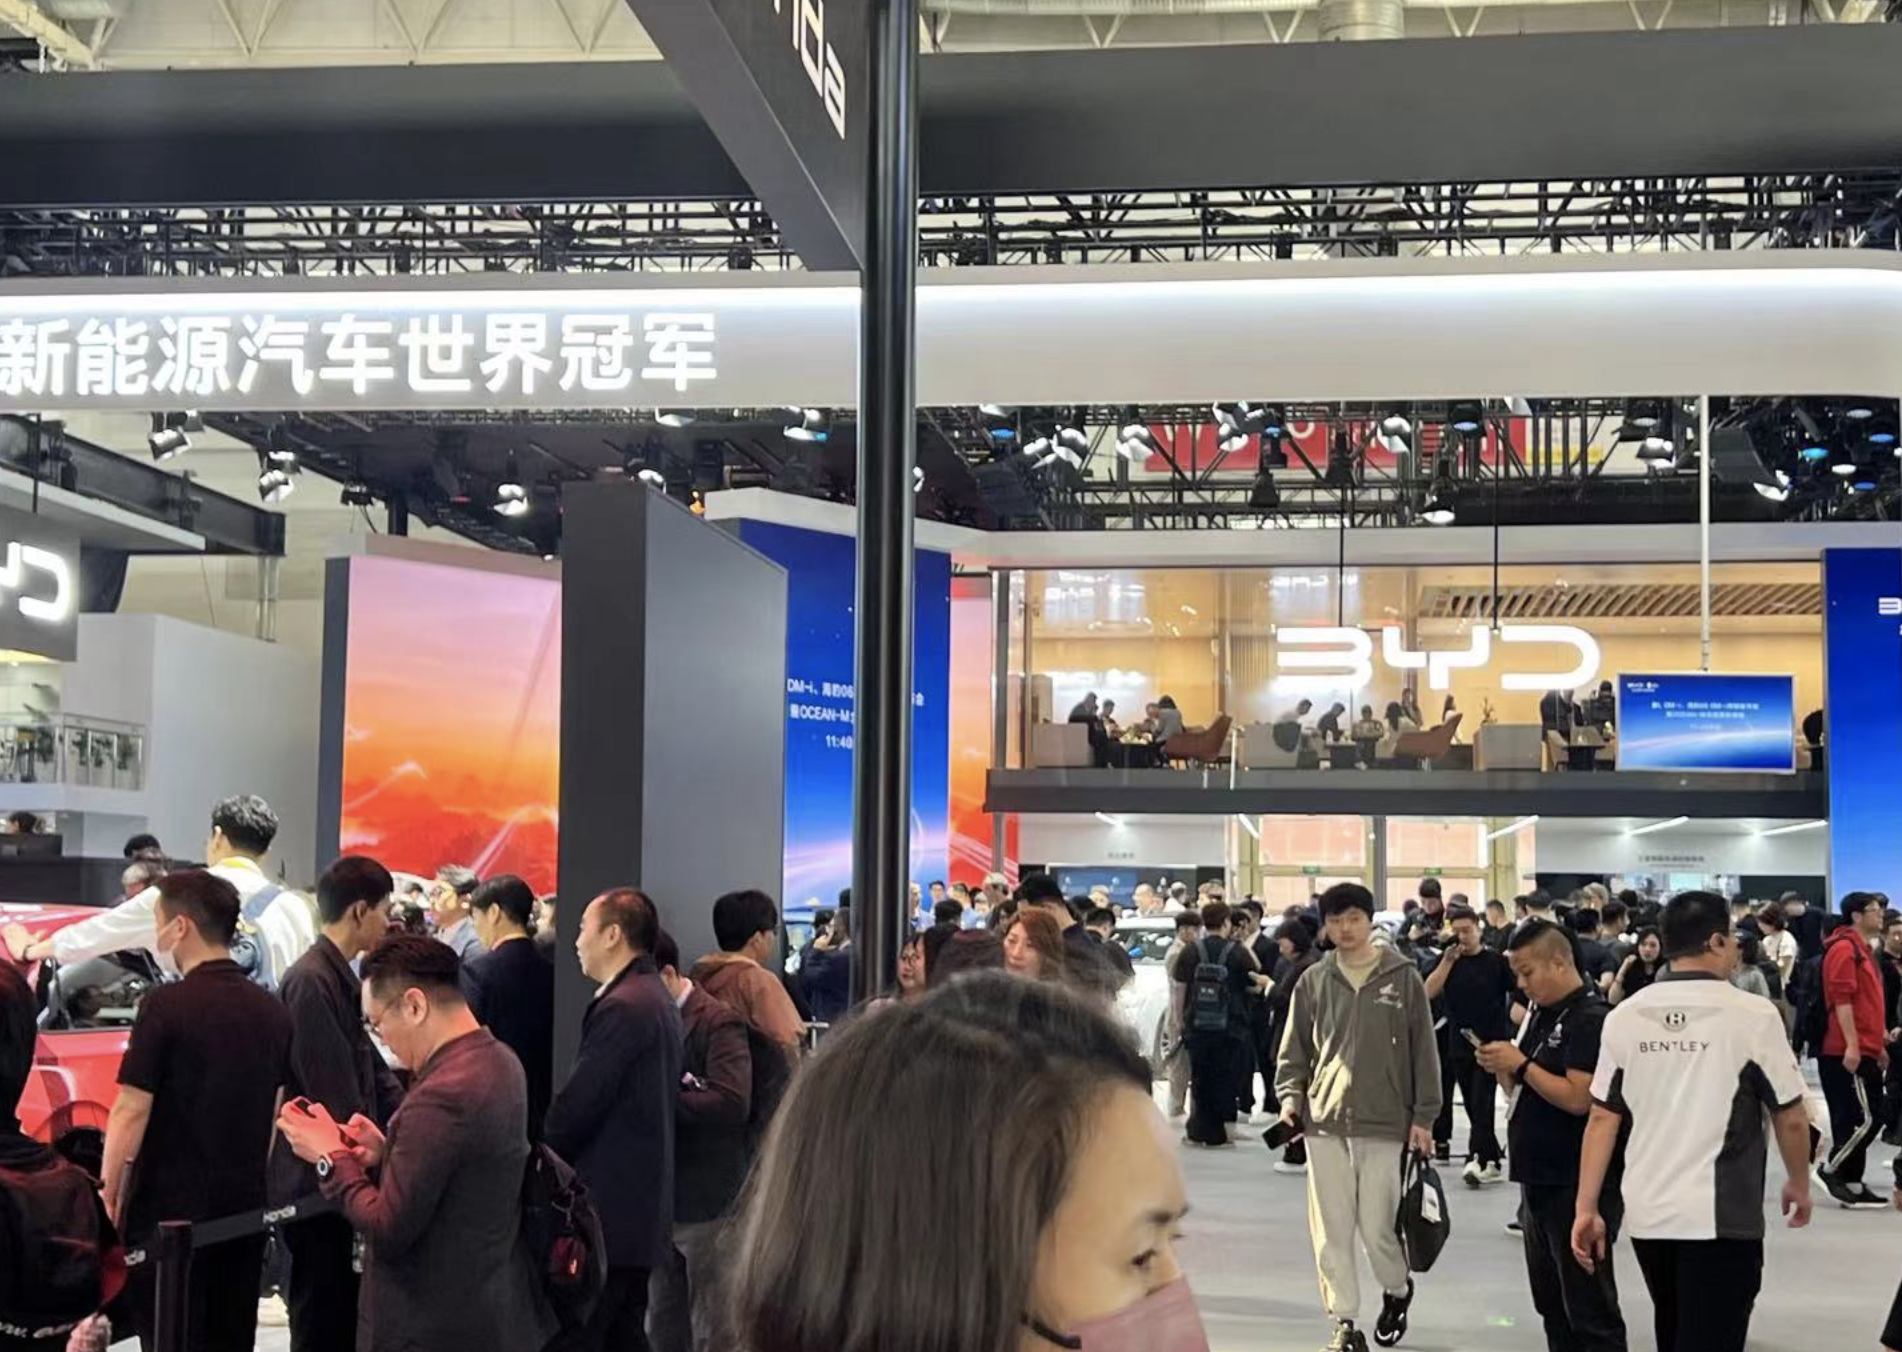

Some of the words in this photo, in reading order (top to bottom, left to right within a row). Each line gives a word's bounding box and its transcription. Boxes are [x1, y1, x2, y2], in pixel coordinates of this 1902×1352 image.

[774, 0, 845, 140] da
[0, 312, 717, 396] 新能源汽车世界冠军
[1276, 625, 1601, 690] BYD
[1639, 1040, 1711, 1054] BENTLEY
